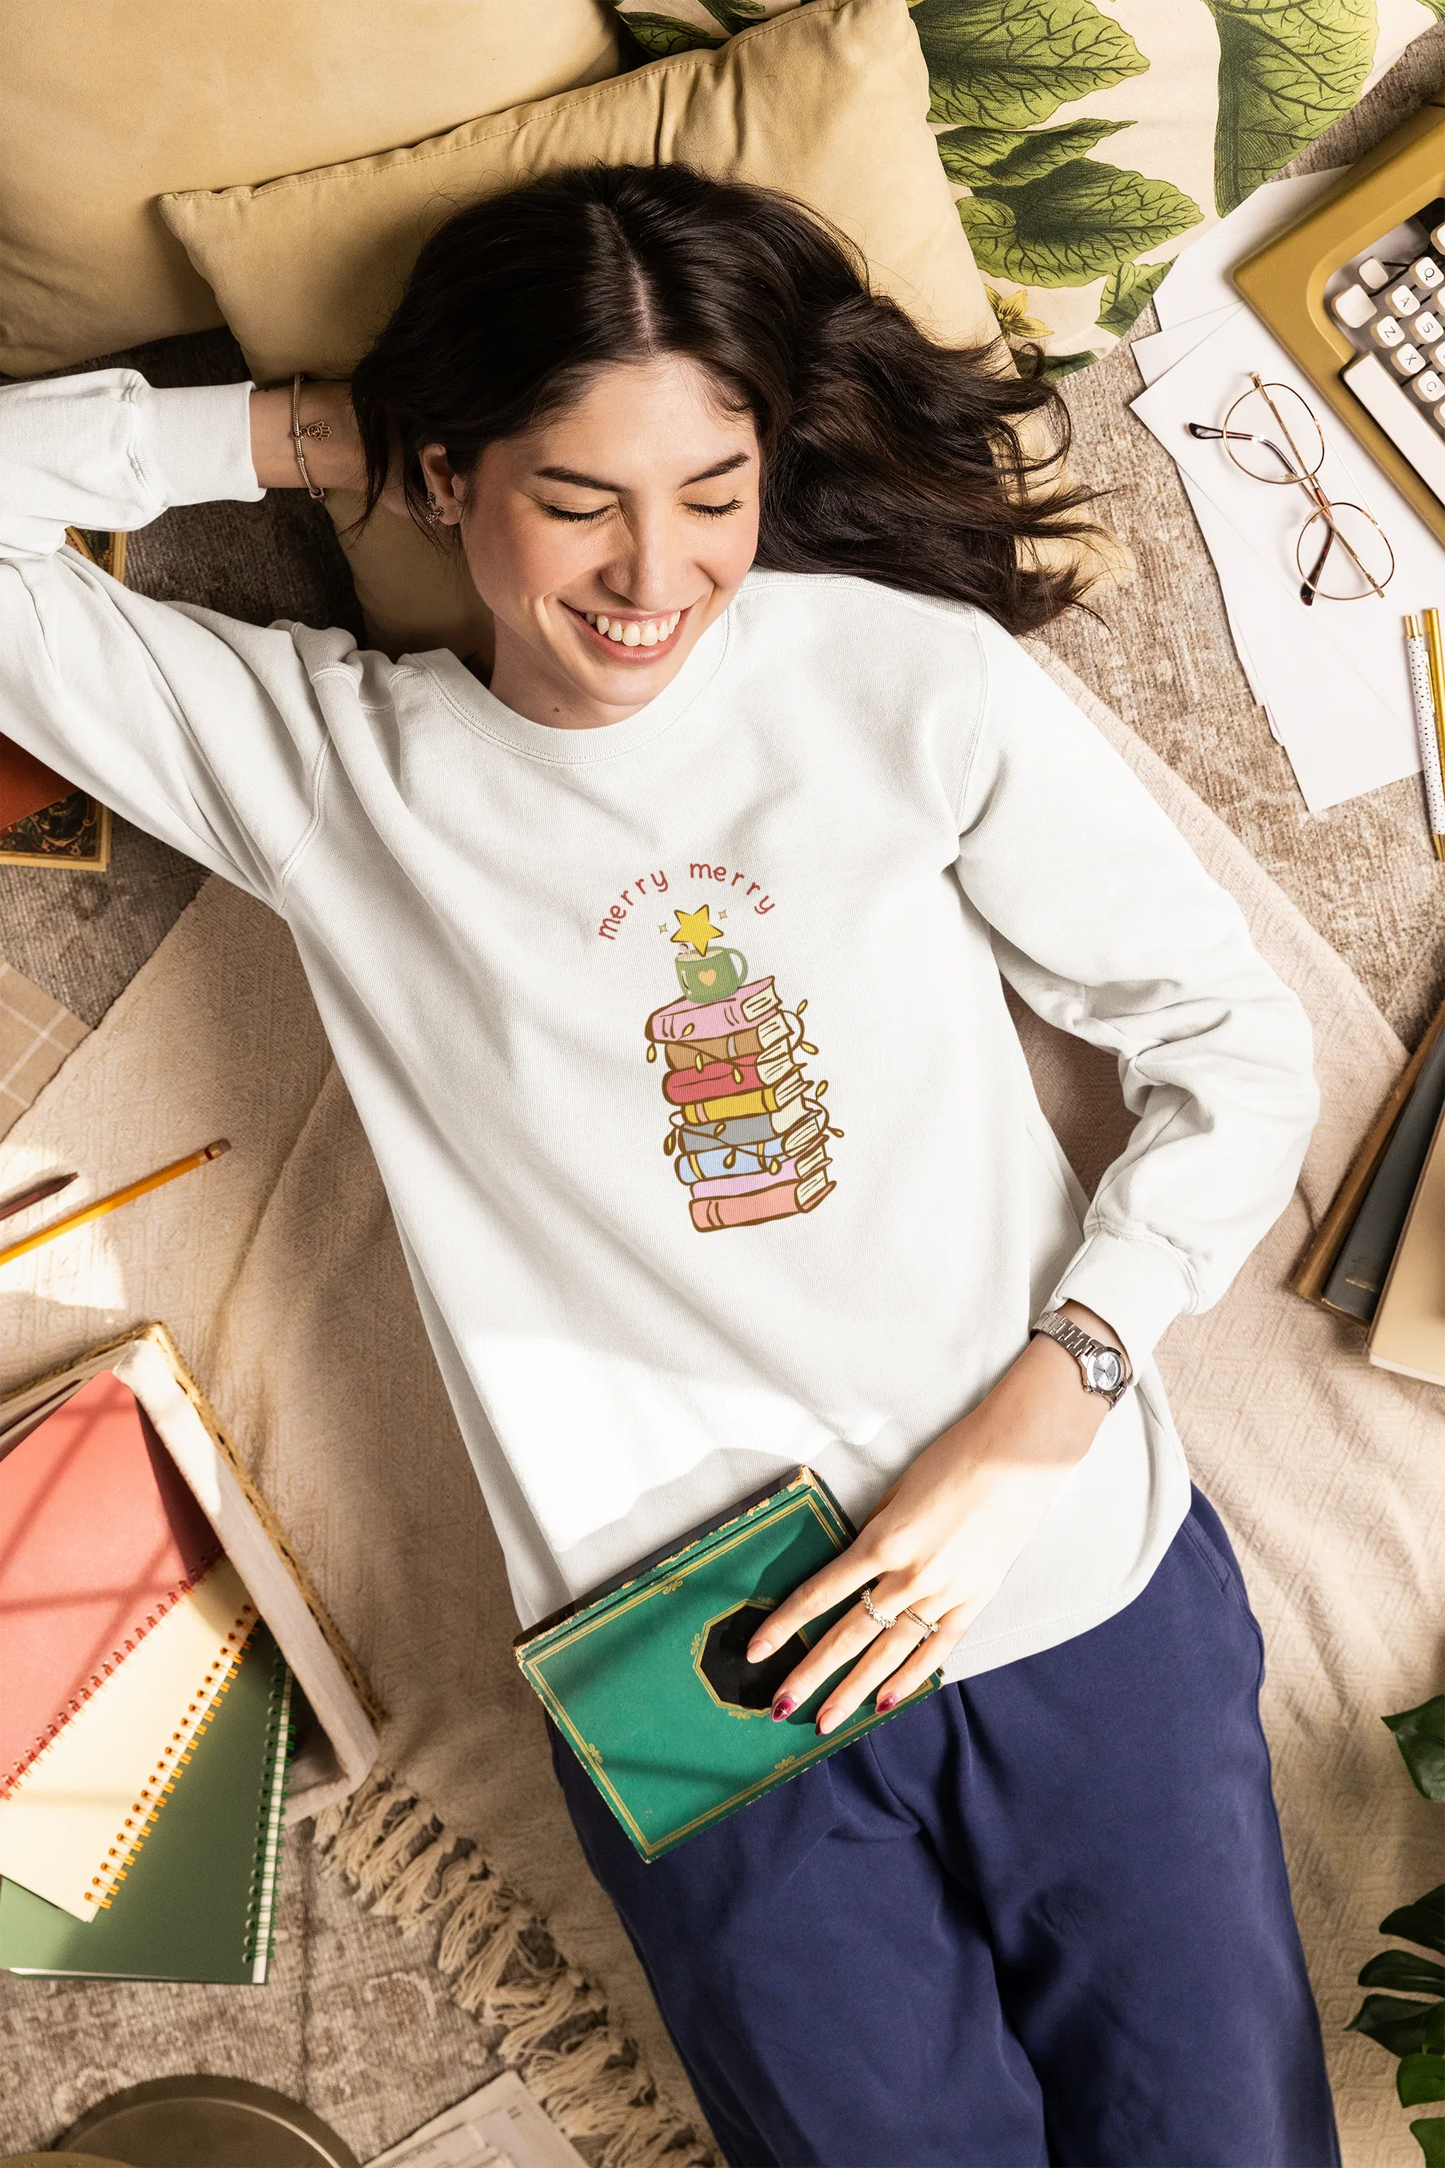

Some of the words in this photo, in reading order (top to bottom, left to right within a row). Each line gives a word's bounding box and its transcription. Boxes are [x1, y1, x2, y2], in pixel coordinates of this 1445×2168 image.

[1424, 267, 1435, 281] Q
[1400, 297, 1410, 307] A
[1384, 326, 1396, 338] Z
[1422, 322, 1434, 333] S
[1405, 353, 1417, 365] X
[1426, 381, 1437, 392] C
[598, 870, 669, 940] merry
[689, 862, 775, 915] merry
